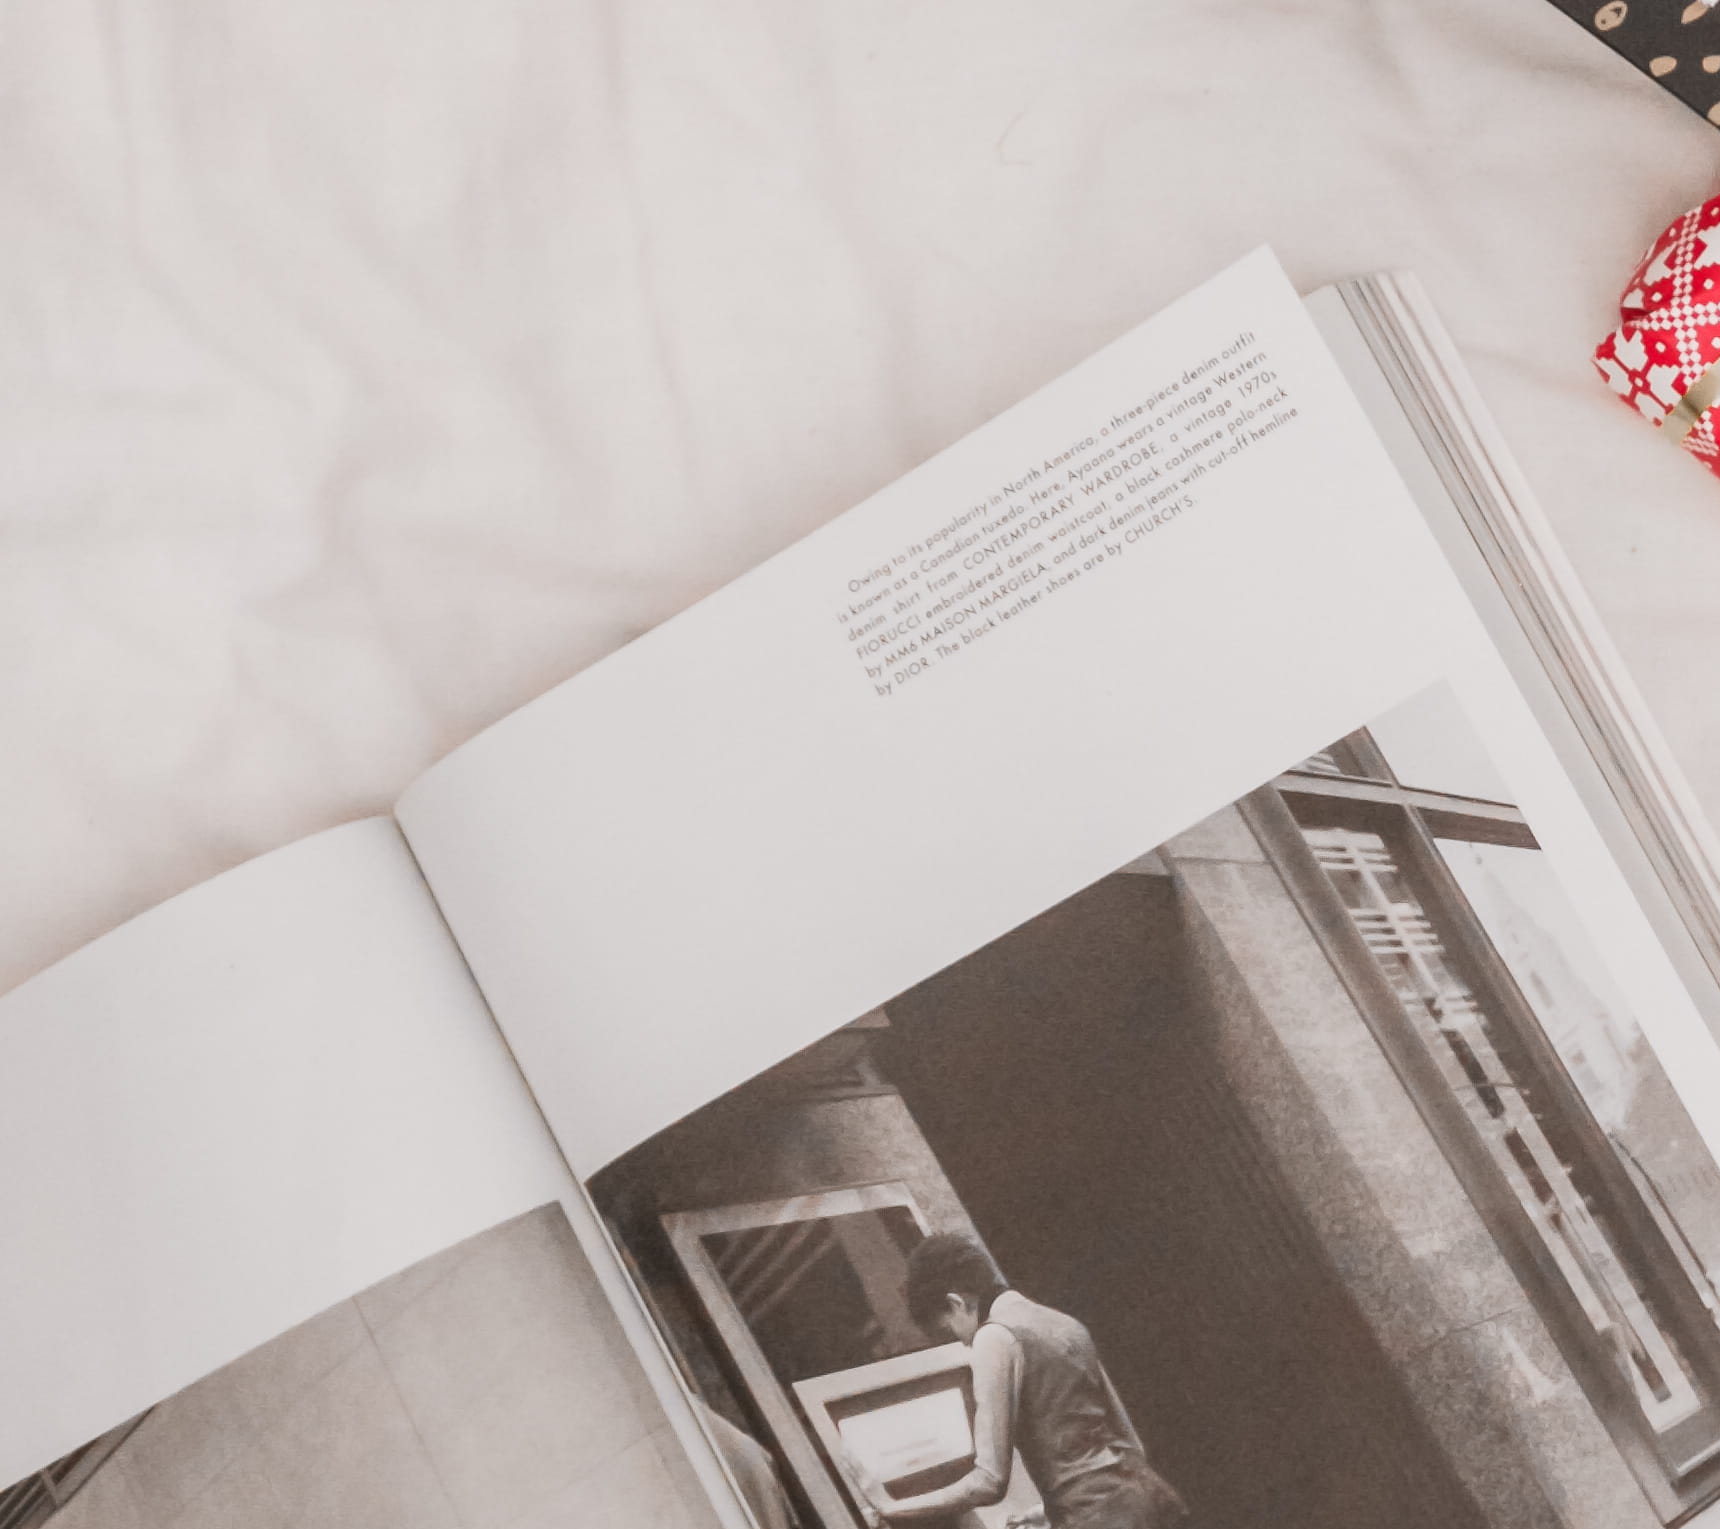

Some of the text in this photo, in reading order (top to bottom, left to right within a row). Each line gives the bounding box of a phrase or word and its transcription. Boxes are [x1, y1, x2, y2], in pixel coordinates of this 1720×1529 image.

[847, 563, 893, 593] Owing
[891, 554, 907, 567] to
[924, 503, 988, 551] popularity
[988, 495, 1003, 507] in
[1001, 467, 1042, 498] North
[1099, 426, 1111, 438] a
[1110, 382, 1180, 430] three-piece
[1181, 357, 1220, 385] denim
[1221, 331, 1256, 360] outfit
[847, 614, 887, 642] denim
[892, 591, 921, 615] shirt
[925, 570, 959, 593] from
[963, 493, 1074, 570] CONTEMPORARY
[1169, 432, 1180, 443] a
[1183, 399, 1233, 433] vintage
[1237, 370, 1278, 399] 1970s
[848, 587, 892, 616] known
[893, 577, 909, 591] as
[909, 570, 920, 581] a
[919, 533, 981, 573] Canadian
[1115, 423, 1154, 451] wears
[1155, 416, 1166, 427] a
[1165, 386, 1213, 419] vintage
[1212, 352, 1267, 388] Western
[856, 614, 922, 659] FIORUCCI
[925, 562, 1004, 619] embroidered
[1007, 541, 1045, 569] denim
[1114, 491, 1125, 503] a
[1124, 466, 1163, 494] black
[1164, 429, 1224, 471] cashmere
[1226, 386, 1288, 435] polo-neck
[863, 664, 883, 679] by
[884, 640, 919, 668] MM6
[919, 603, 978, 646] MAISON
[1052, 541, 1078, 565] and
[1078, 524, 1108, 550] dark
[1108, 503, 1146, 531] denim
[1144, 482, 1179, 511] jeans
[1179, 463, 1207, 488] with
[1207, 432, 1250, 469] cut-off
[1247, 408, 1298, 442] hemline
[874, 680, 893, 697] by
[935, 641, 961, 659] The
[959, 617, 997, 645] black
[995, 590, 1042, 622] leather
[1045, 568, 1081, 594] shoes
[1082, 553, 1105, 571] are
[1103, 541, 1123, 557] by
